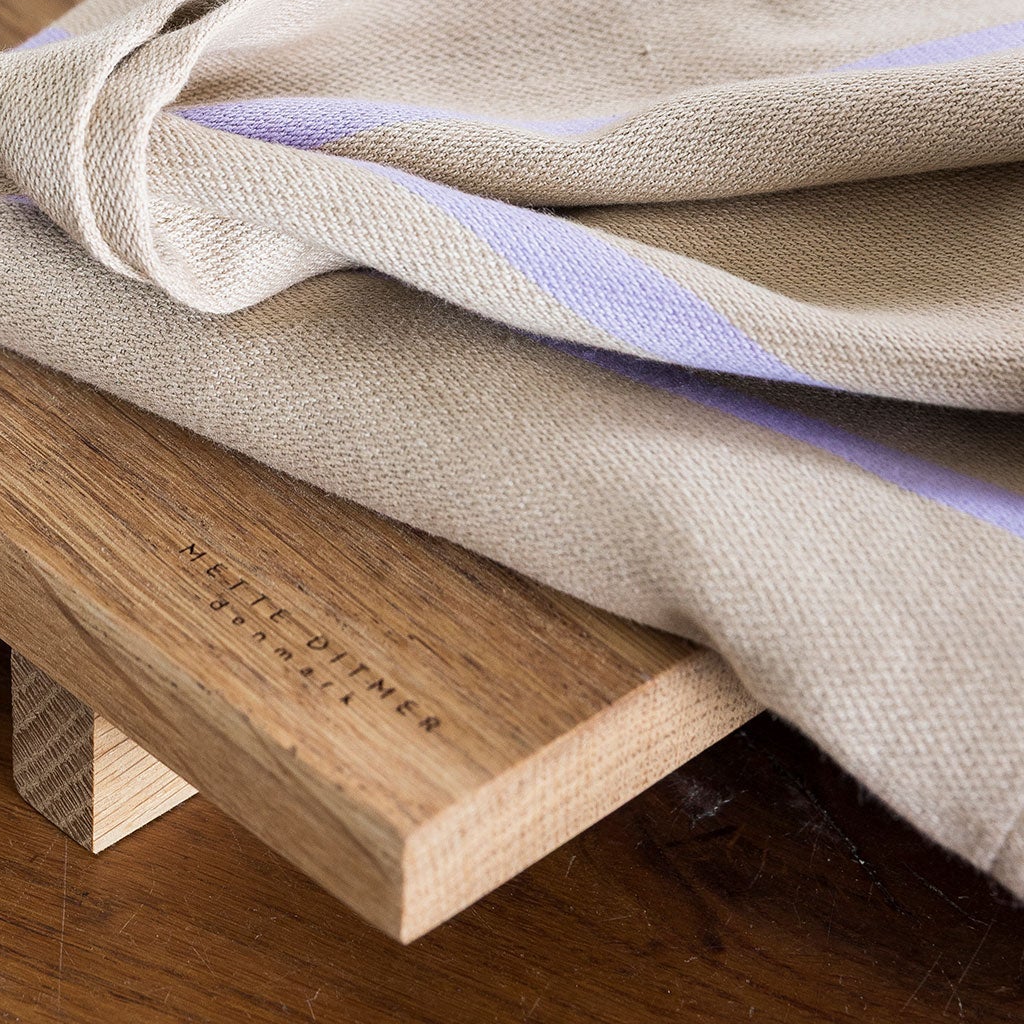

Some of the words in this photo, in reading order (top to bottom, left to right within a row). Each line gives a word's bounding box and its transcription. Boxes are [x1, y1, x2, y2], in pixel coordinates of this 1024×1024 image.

[179, 543, 291, 624] METTE
[307, 635, 441, 732] DITMER
[209, 593, 355, 706] denmark
